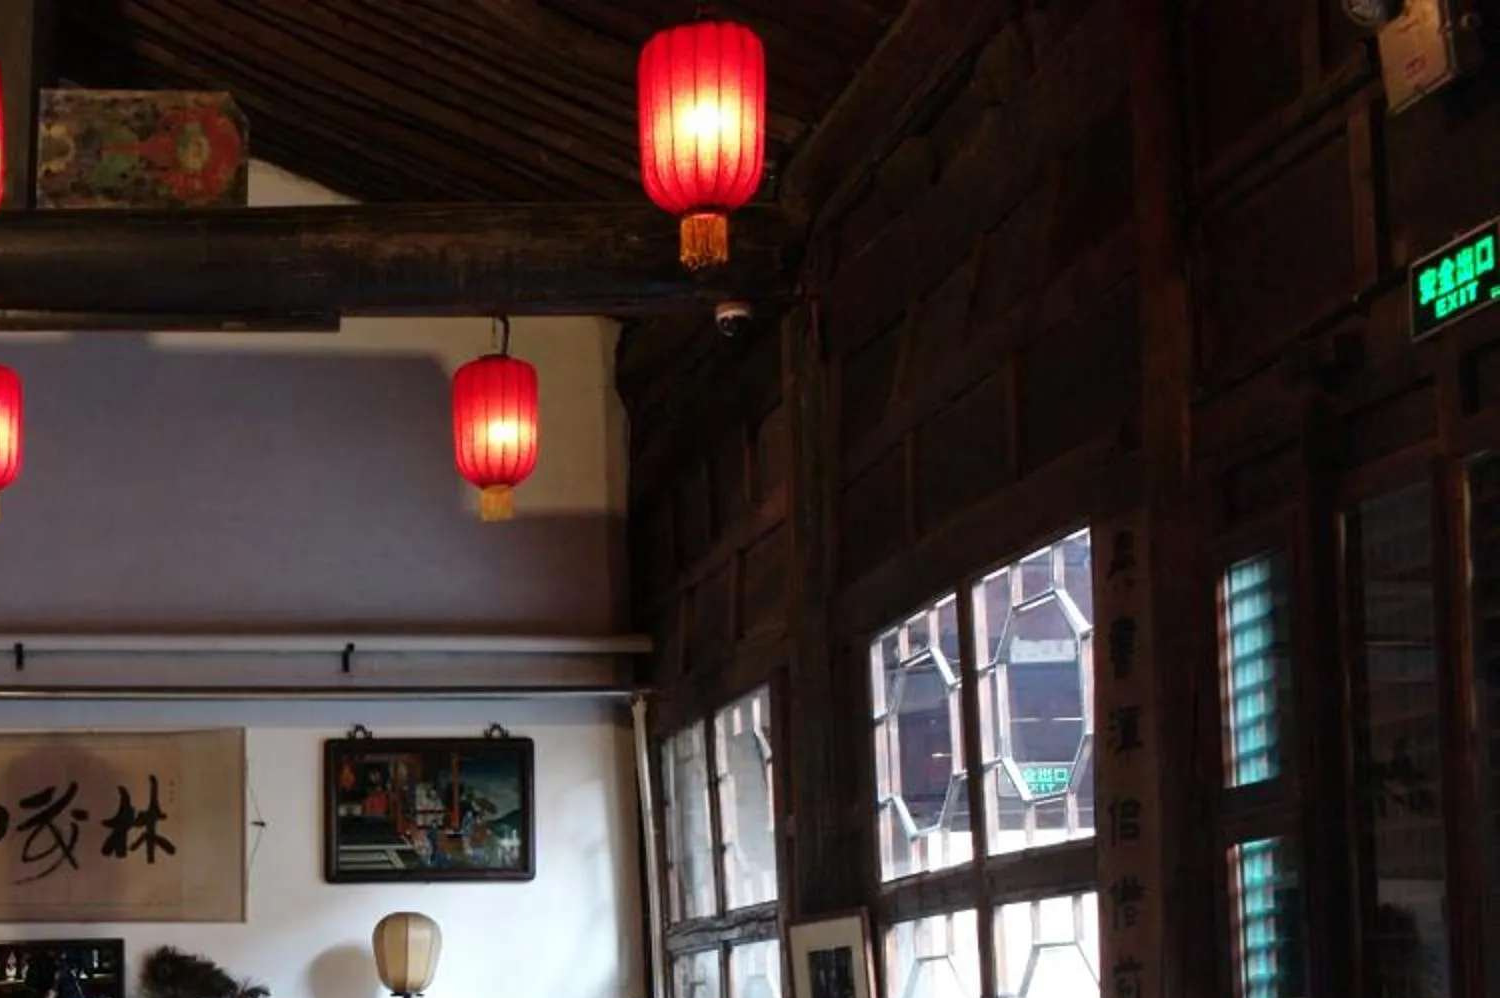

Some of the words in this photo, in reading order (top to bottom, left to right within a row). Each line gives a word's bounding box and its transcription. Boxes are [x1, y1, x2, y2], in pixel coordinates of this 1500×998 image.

[1435, 280, 1479, 318] EXIT
[1021, 767, 1069, 783] 全出口
